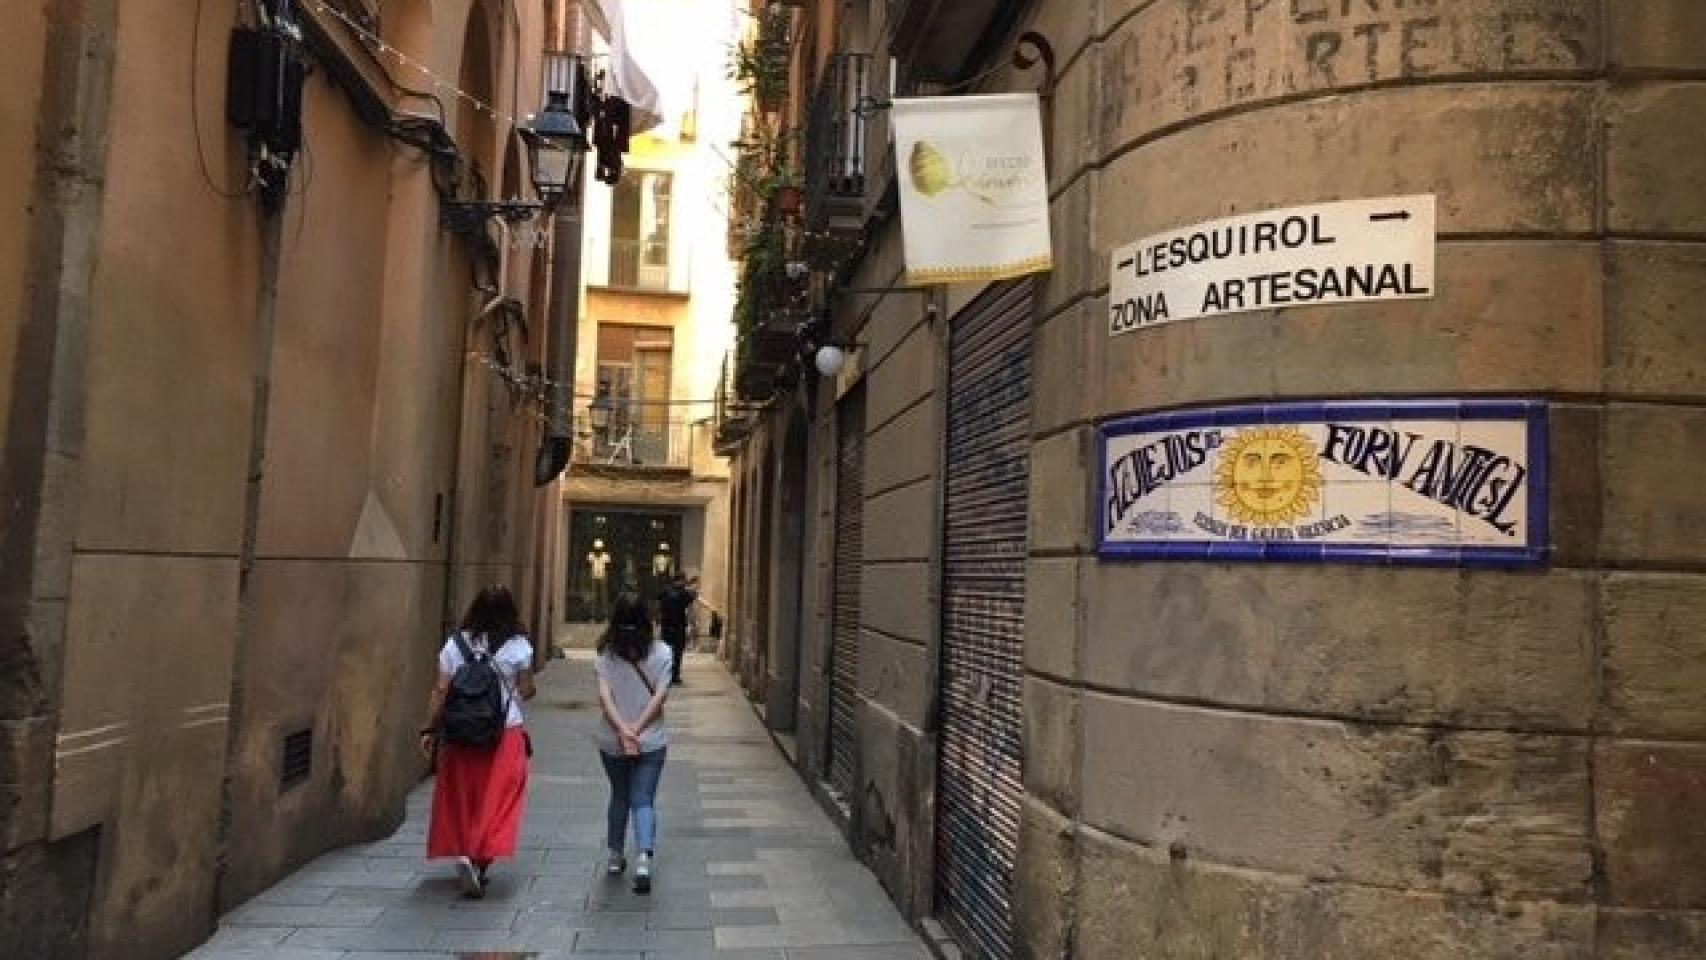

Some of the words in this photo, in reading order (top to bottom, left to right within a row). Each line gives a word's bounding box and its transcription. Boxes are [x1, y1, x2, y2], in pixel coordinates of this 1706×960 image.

[1135, 215, 1336, 276] L'ESQUIROL
[1111, 291, 1169, 331] ZONA
[1201, 264, 1429, 313] ARTESANAL
[1318, 423, 1424, 481] FORN
